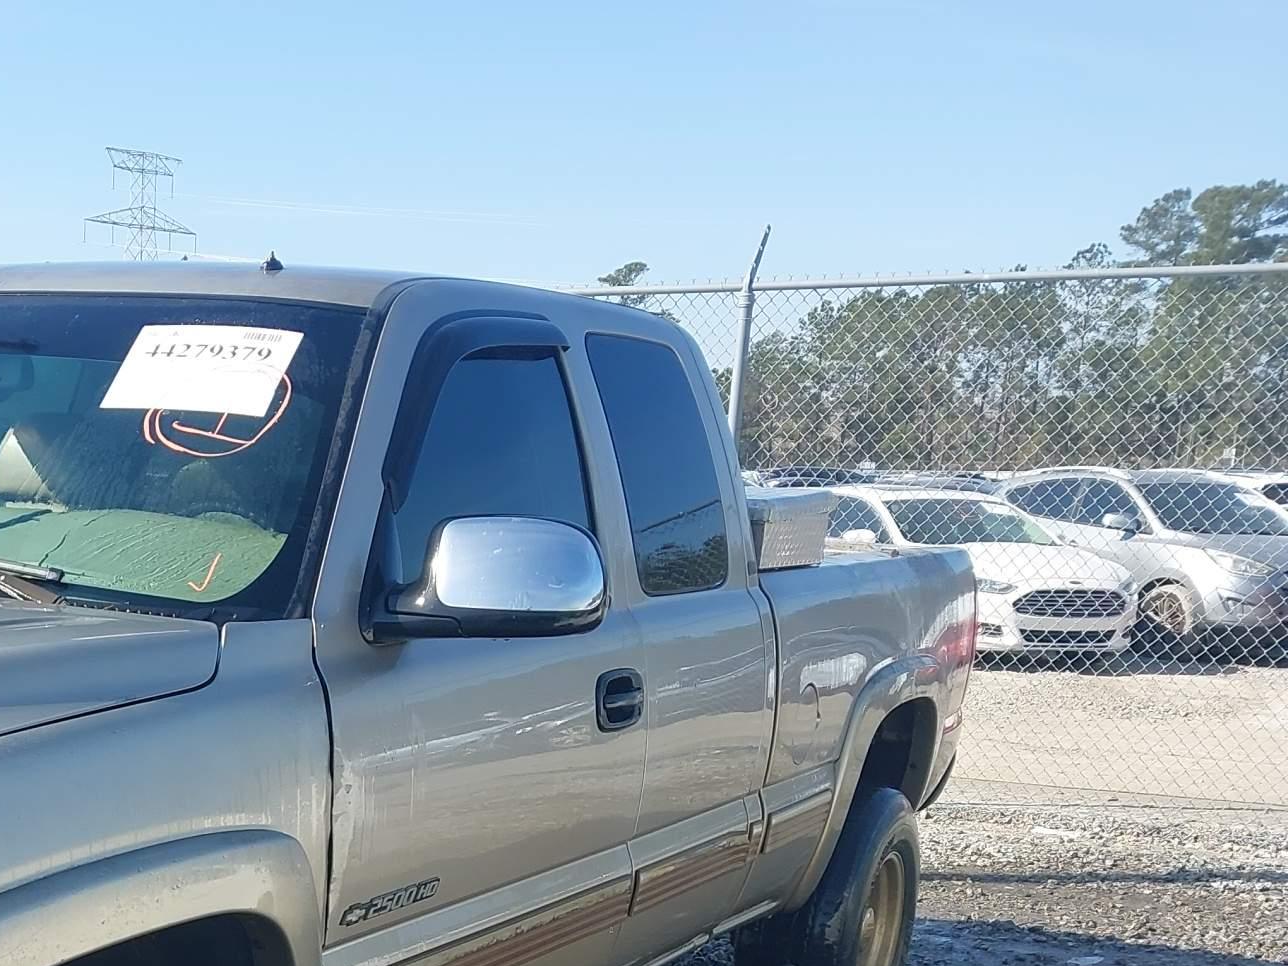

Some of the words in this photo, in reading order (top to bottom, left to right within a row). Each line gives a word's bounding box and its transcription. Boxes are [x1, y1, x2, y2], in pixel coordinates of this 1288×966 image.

[145, 343, 272, 361] 44279379
[368, 886, 416, 918] 2500
[416, 881, 439, 900] HD
